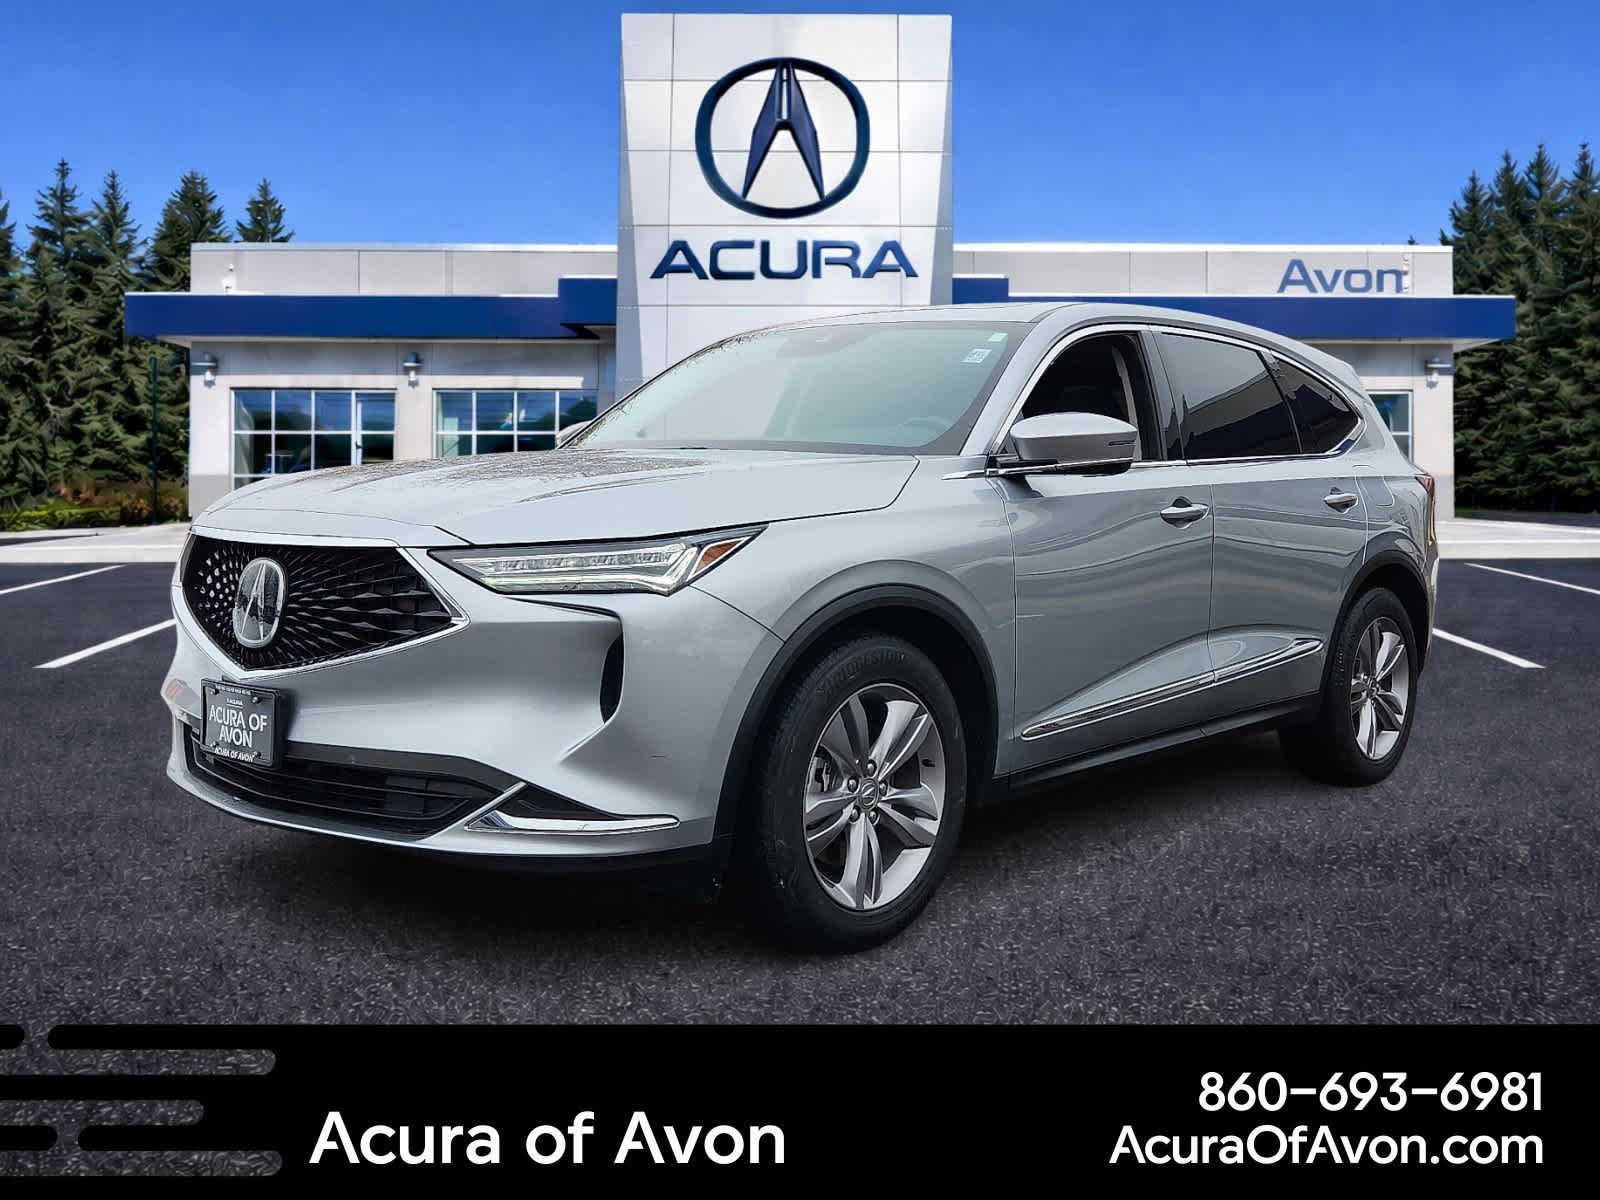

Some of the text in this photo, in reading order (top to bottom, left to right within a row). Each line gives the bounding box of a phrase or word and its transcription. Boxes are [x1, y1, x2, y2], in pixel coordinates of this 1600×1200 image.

[650, 240, 919, 280] ACURA
[1277, 259, 1404, 294] Avon
[209, 704, 268, 732] ACURA OF
[219, 725, 253, 748] AVON
